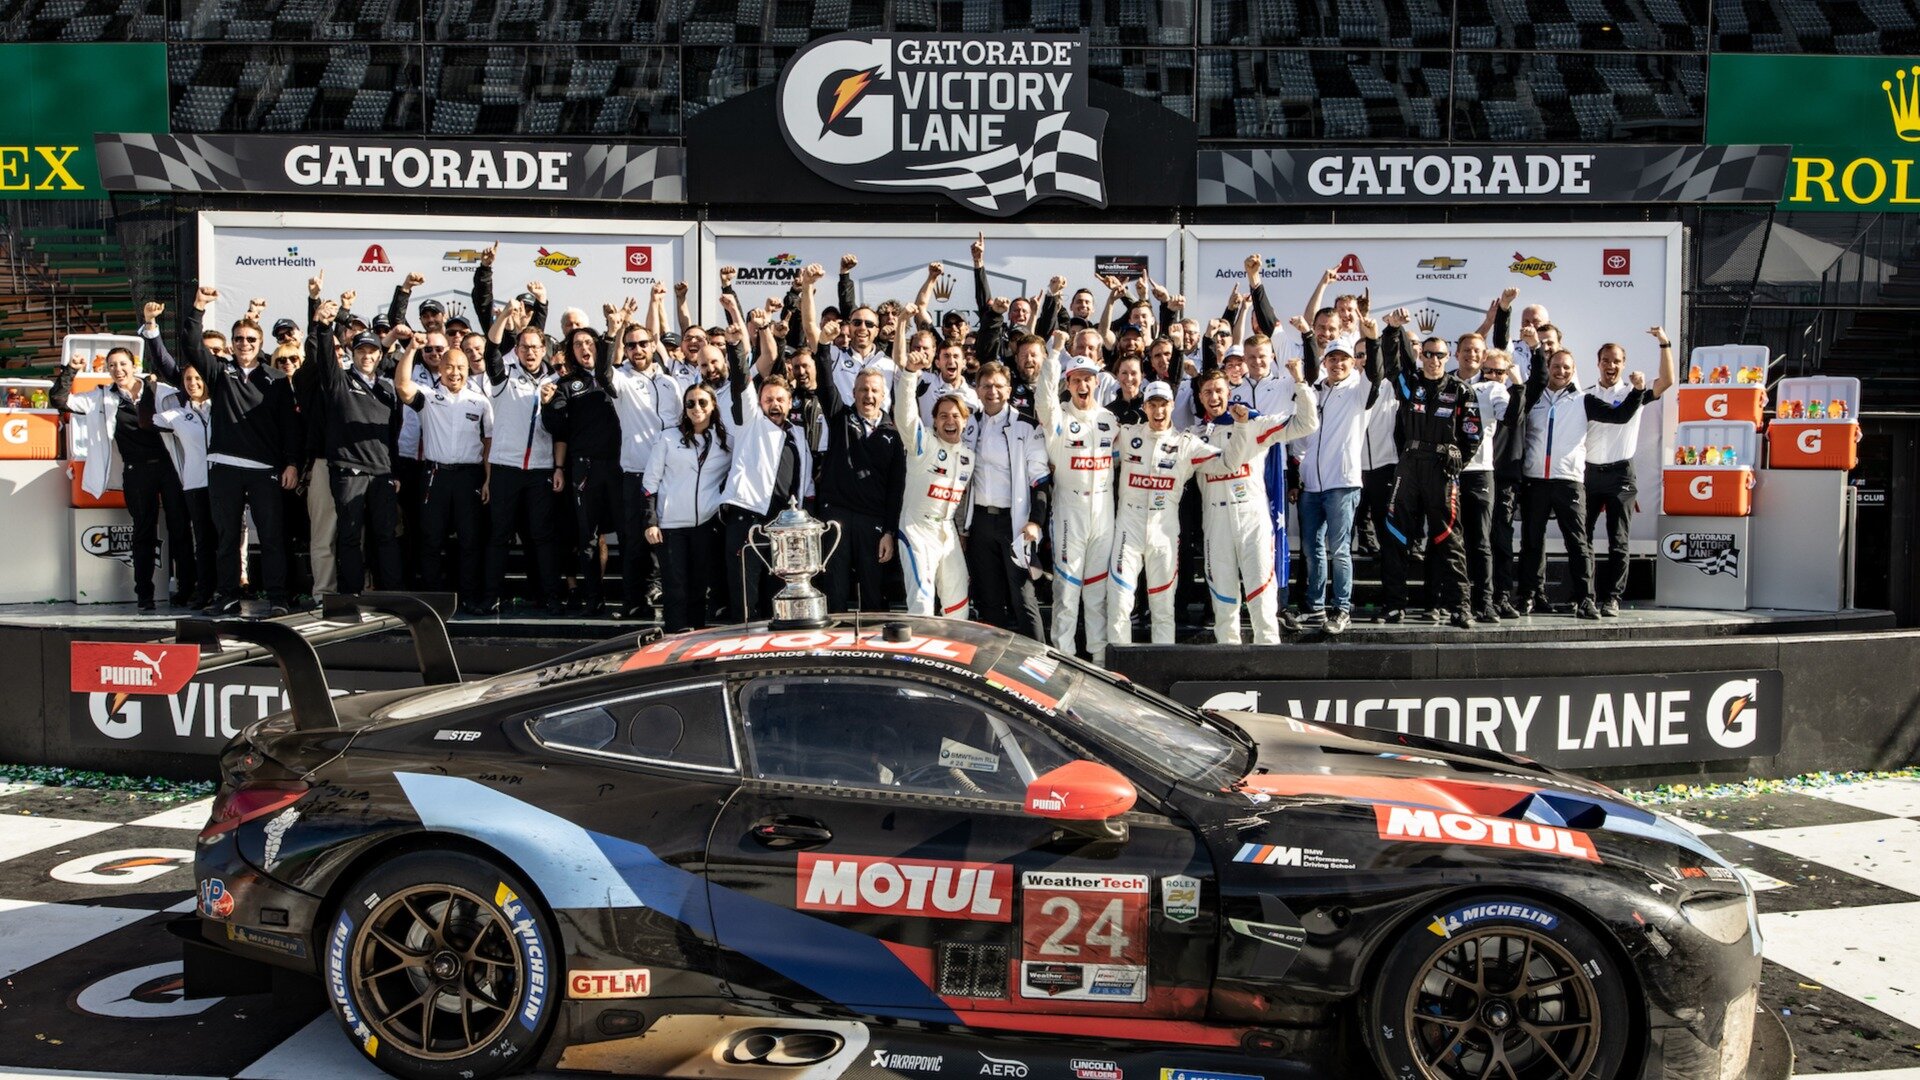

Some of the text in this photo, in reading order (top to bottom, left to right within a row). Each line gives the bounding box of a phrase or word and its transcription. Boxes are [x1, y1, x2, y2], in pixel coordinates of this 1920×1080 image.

[897, 71, 1073, 111] VICTORY
[902, 113, 1006, 151] LANE
[284, 144, 569, 191] GATORADE
[1307, 155, 1591, 196] GATORADE
[357, 265, 394, 273] AXALTA
[537, 258, 578, 267] SUNOCO
[1512, 262, 1553, 271] SUNOCO
[737, 267, 800, 280] DAYTON
[1598, 280, 1634, 288] TOYOTA
[1130, 475, 1173, 489] MOTUL
[111, 533, 133, 541] VICT
[111, 541, 133, 550] LAN
[1689, 541, 1732, 549] VICTORY
[1689, 549, 1713, 557] LANE
[691, 630, 961, 659] MOTUL
[101, 665, 153, 686] PUMA
[735, 650, 1057, 718] EDWARDS KROHN MOSTERT FARFUS
[1558, 690, 1691, 751] LANE
[450, 731, 482, 741] STEP
[1032, 799, 1061, 811] PUMA
[1386, 807, 1588, 858] MOTUL
[1303, 848, 1324, 856] BMW
[1303, 855, 1349, 863] Performance
[1303, 861, 1329, 869] Driving
[804, 859, 1003, 916] MOTUL
[1027, 874, 1143, 889] WeatherTech
[1166, 880, 1196, 888] ROLEX
[1167, 889, 1195, 902] 24
[1462, 904, 1554, 926] MICHELIN
[1039, 896, 1131, 958] 24
[248, 933, 298, 951] MICHELIN
[331, 921, 358, 1023] MICHELIN
[516, 917, 545, 1022] MICHELIN
[572, 974, 646, 994] GTLM
[979, 1063, 1028, 1078] AERO
[1073, 1060, 1114, 1070] LINCOLN
[1082, 1070, 1118, 1079] WELDERS
